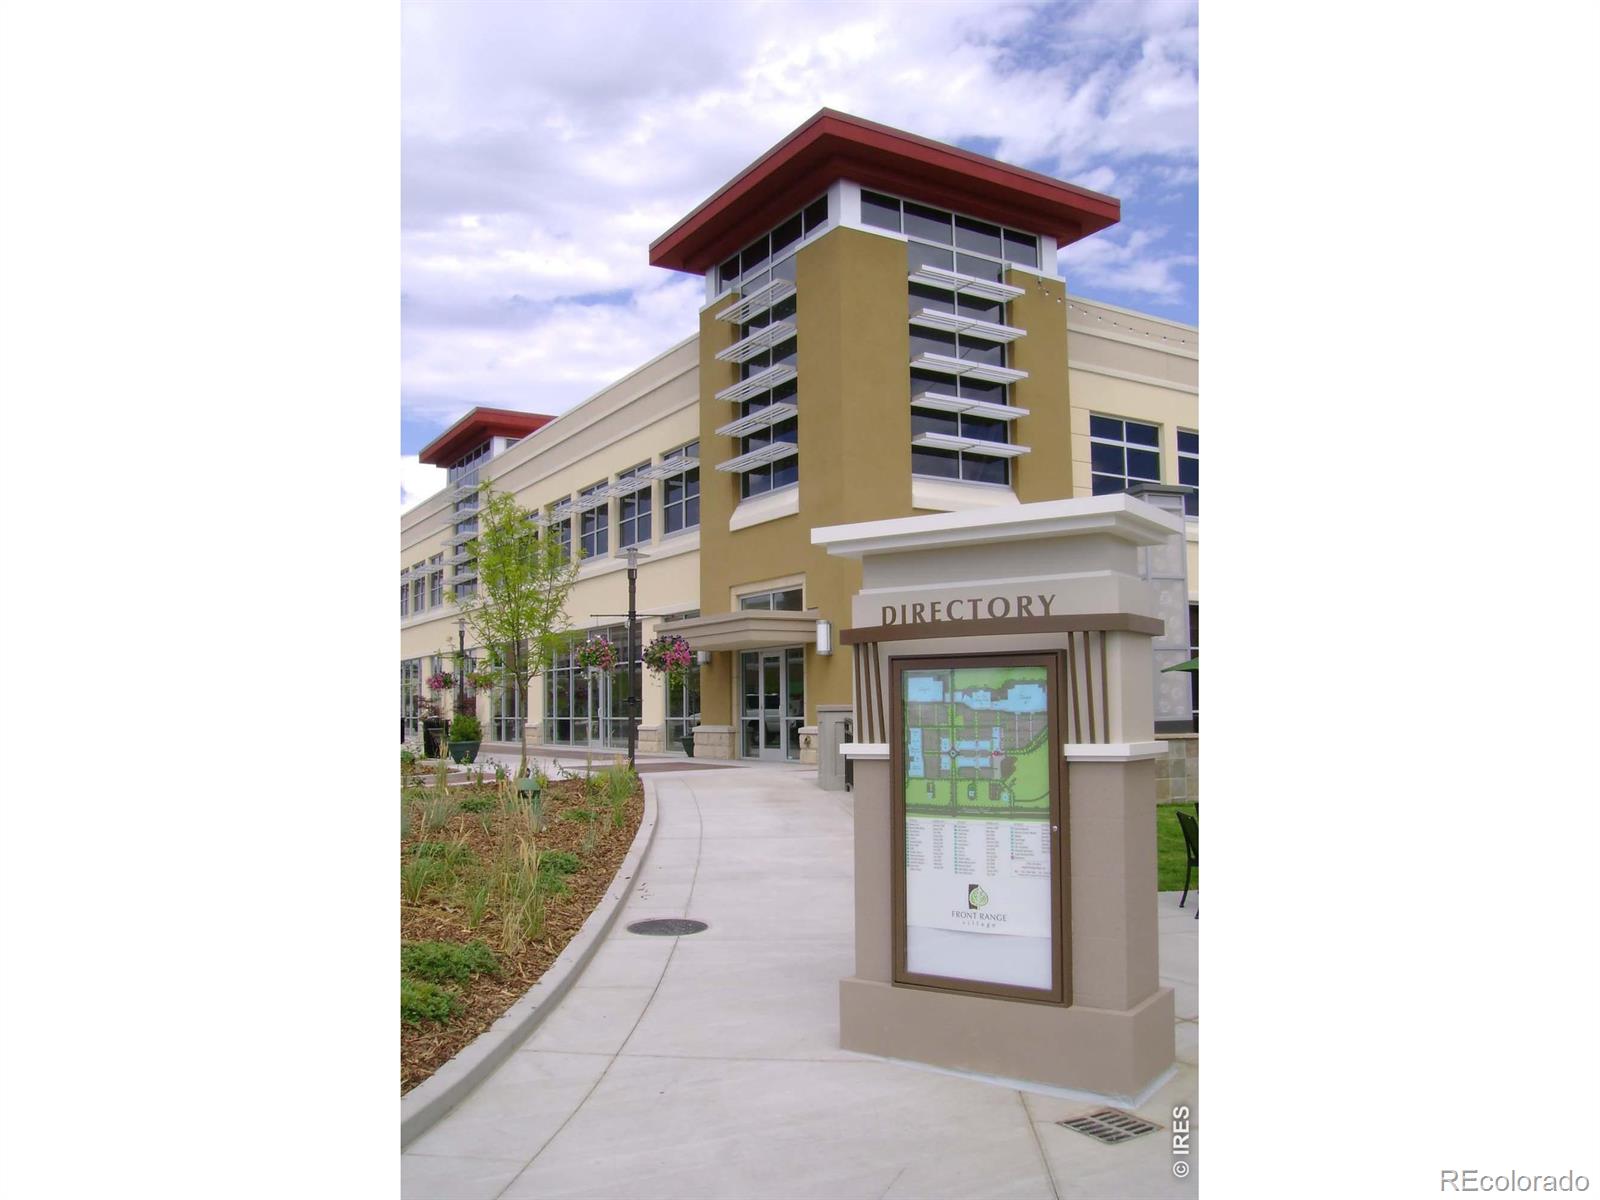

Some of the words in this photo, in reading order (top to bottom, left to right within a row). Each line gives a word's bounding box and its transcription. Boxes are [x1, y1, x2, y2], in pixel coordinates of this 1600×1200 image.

[881, 594, 1056, 626] DIRECTORY
[951, 910, 977, 920] FRONT
[979, 912, 1007, 922] RANGE
